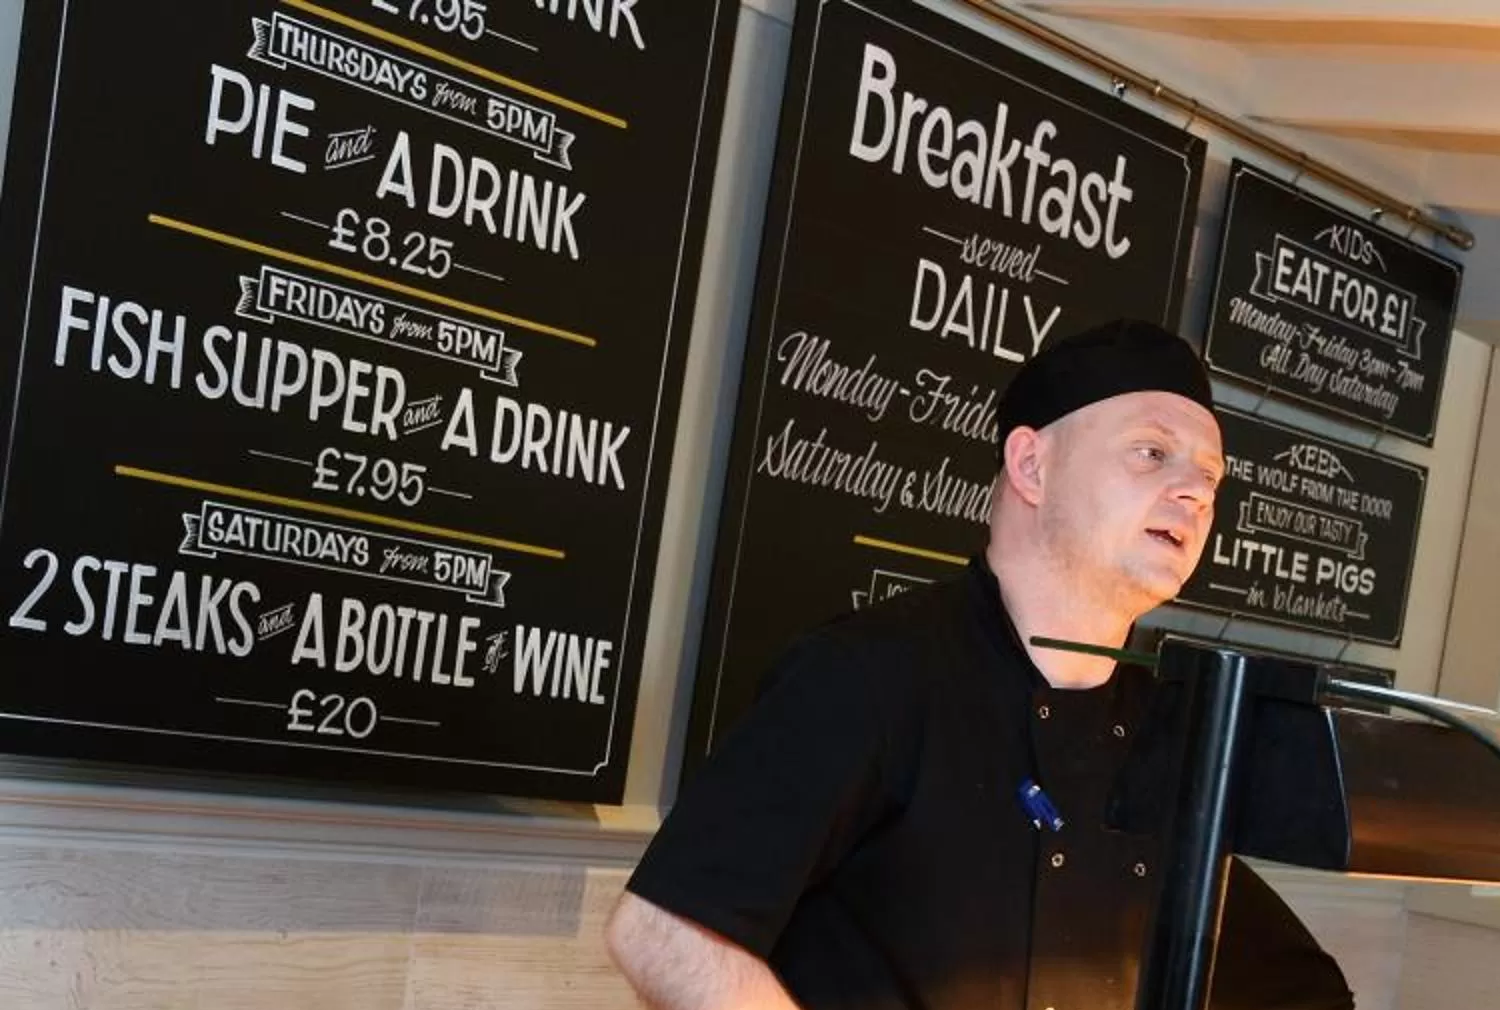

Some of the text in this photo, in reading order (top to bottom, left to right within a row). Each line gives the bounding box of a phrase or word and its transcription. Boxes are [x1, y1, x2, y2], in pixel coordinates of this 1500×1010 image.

[278, 22, 548, 143] THURSDAYS from 5PM
[206, 64, 586, 259] PIE and A DRINK
[850, 43, 1133, 259] Breakfast
[328, 208, 453, 279] £8.25
[960, 234, 1040, 283] served
[1329, 224, 1374, 265] KIDS
[269, 275, 497, 362] FRIDAYS from 5PM
[910, 258, 1061, 363] DAILY
[1274, 247, 1330, 306] EAT
[1330, 271, 1378, 328] FOR
[55, 286, 630, 490] FISH SUPPER and A DRINK
[777, 331, 999, 444] Monday-Frida
[1260, 343, 1399, 419] All Day Saturday
[312, 448, 428, 506] £7.95
[757, 418, 902, 513] Saturday
[900, 471, 916, 508] &
[1225, 455, 1393, 520] THE WOLF FROM THE DOOR
[1289, 444, 1342, 478] KEEP
[208, 510, 487, 588] SATURDAYS from 5PM
[1256, 501, 1354, 544] ENJOY OUR TASTY
[1213, 533, 1376, 596] LITTLE PIGS
[1274, 583, 1349, 622] blankets
[9, 549, 59, 630] 2
[64, 556, 260, 657] STEAKS
[258, 603, 294, 635] and
[291, 593, 325, 667] A
[335, 598, 480, 687] BOTTLE
[514, 625, 612, 704] WINE
[288, 690, 377, 738] £20
